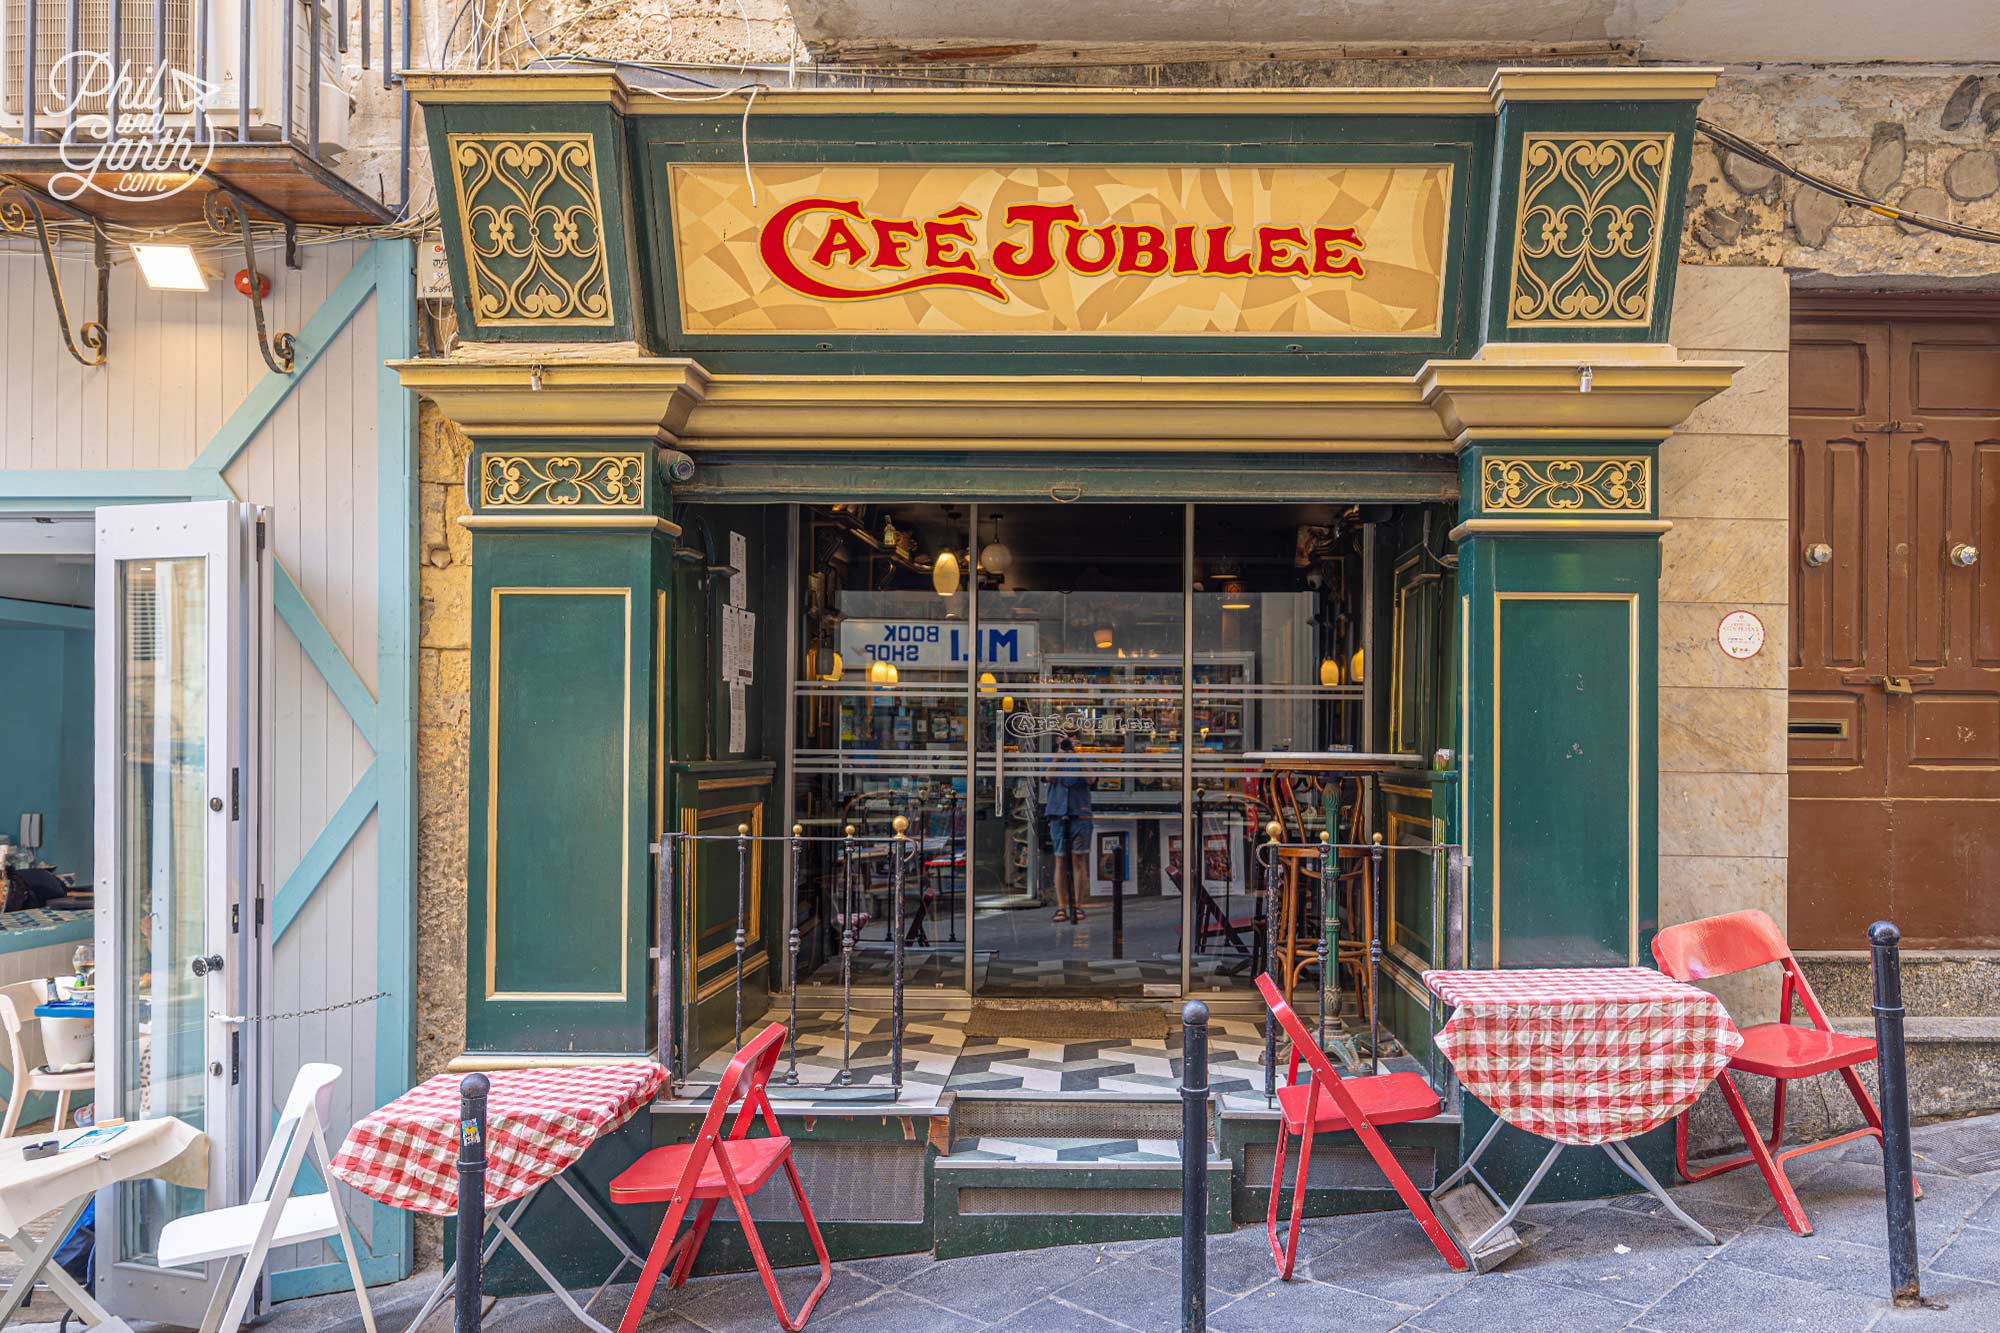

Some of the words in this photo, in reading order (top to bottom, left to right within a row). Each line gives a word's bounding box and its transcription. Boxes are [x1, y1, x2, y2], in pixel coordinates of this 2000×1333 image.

[758, 196, 1010, 304] CAFÉ
[990, 200, 1367, 280] JUBILEE
[1005, 711, 1067, 738] CAFÉ
[1062, 712, 1155, 733] JUBILEE
